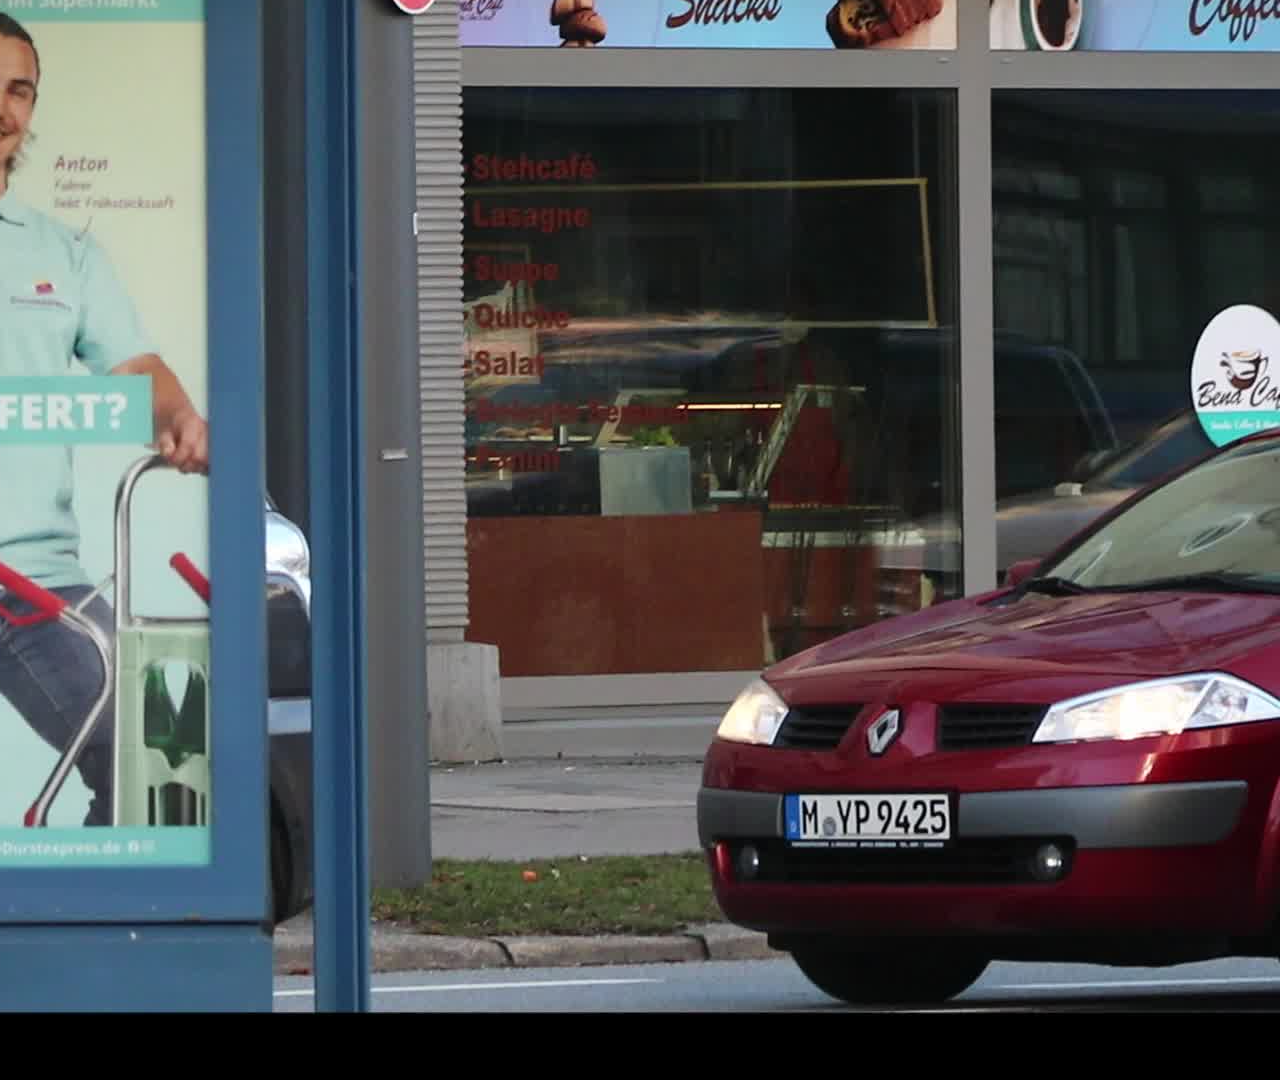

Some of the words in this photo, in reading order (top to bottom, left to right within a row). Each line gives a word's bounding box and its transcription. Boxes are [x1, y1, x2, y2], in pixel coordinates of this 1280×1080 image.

[55, 155, 108, 172] Anton
[472, 152, 597, 180] Stehcafé
[473, 200, 591, 232] Lasagne
[474, 255, 559, 287] Suppe
[472, 303, 569, 330] Quiche
[474, 350, 545, 377] Salat
[802, 800, 819, 835] M
[837, 800, 870, 835] YP
[877, 799, 947, 835] 9425
